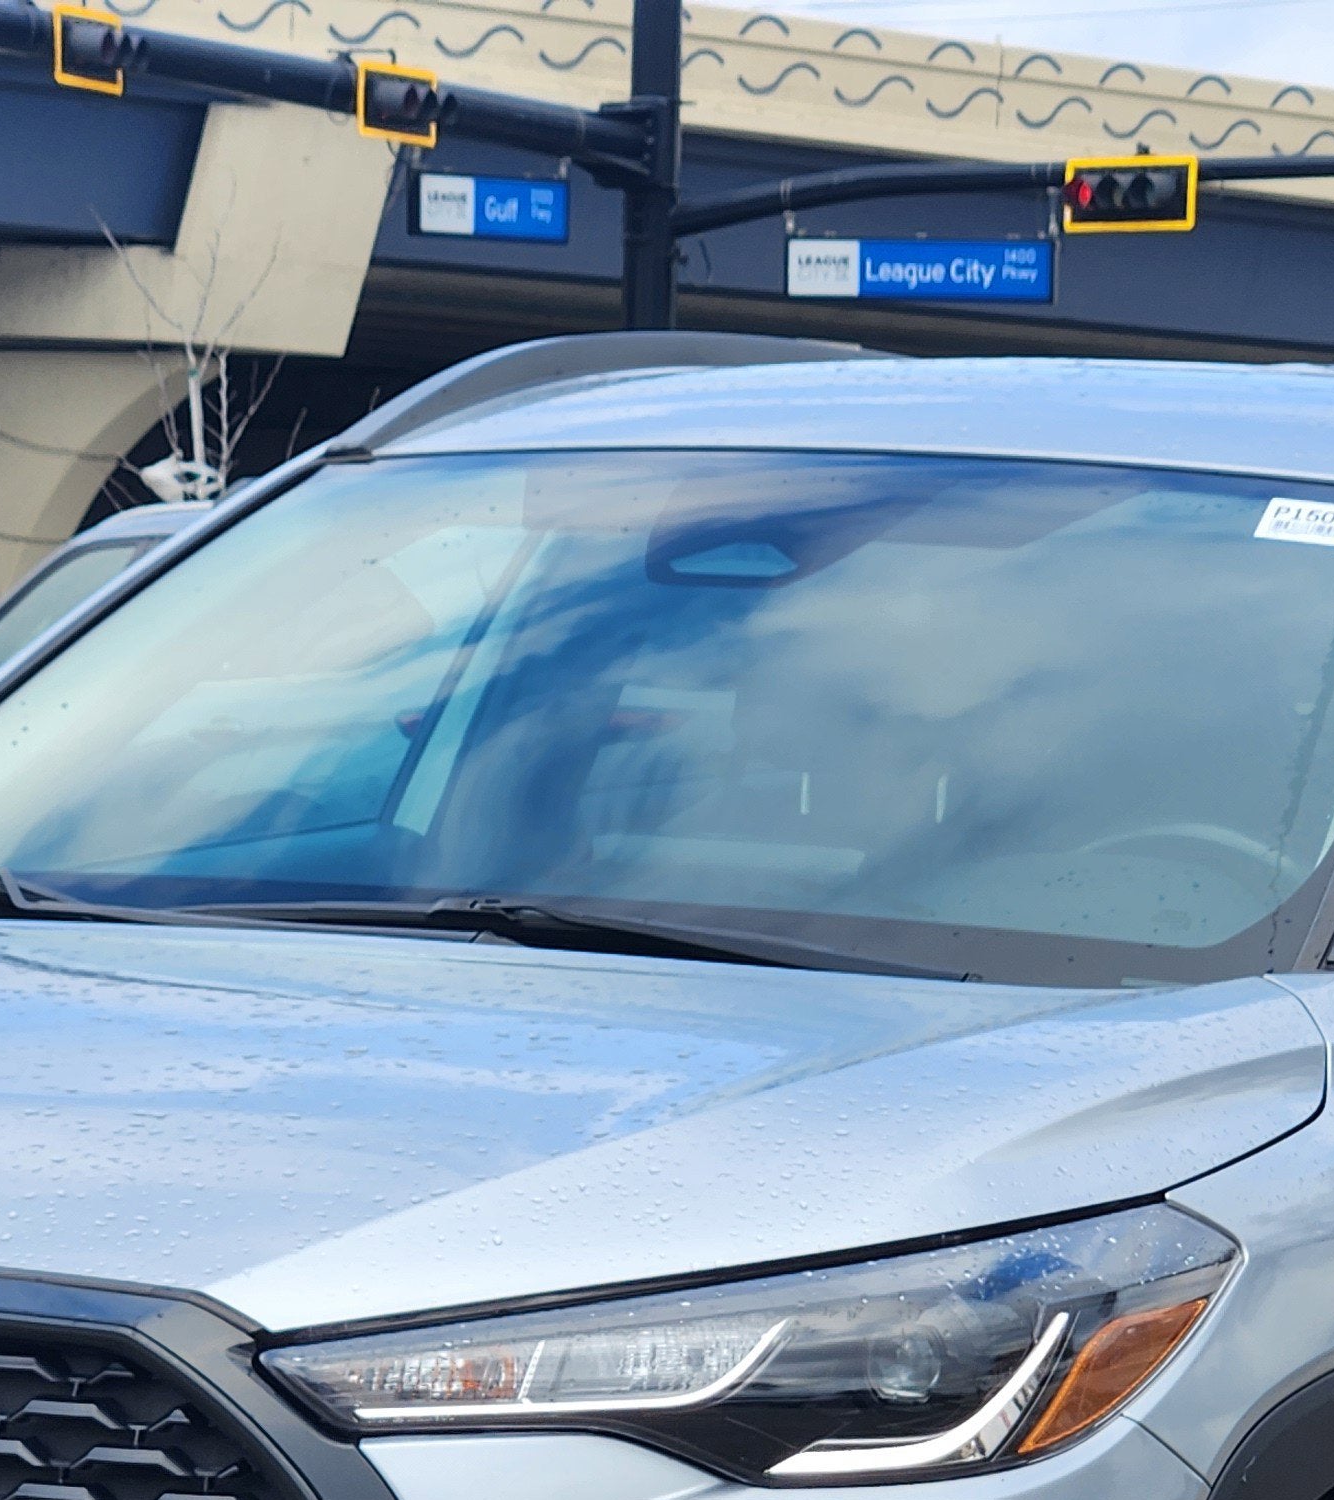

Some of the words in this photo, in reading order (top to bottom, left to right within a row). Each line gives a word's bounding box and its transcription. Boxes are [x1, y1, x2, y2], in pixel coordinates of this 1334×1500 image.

[484, 195, 518, 222] Gulf
[797, 254, 850, 266] LEAGUE
[866, 256, 946, 290] League
[949, 256, 996, 290] City
